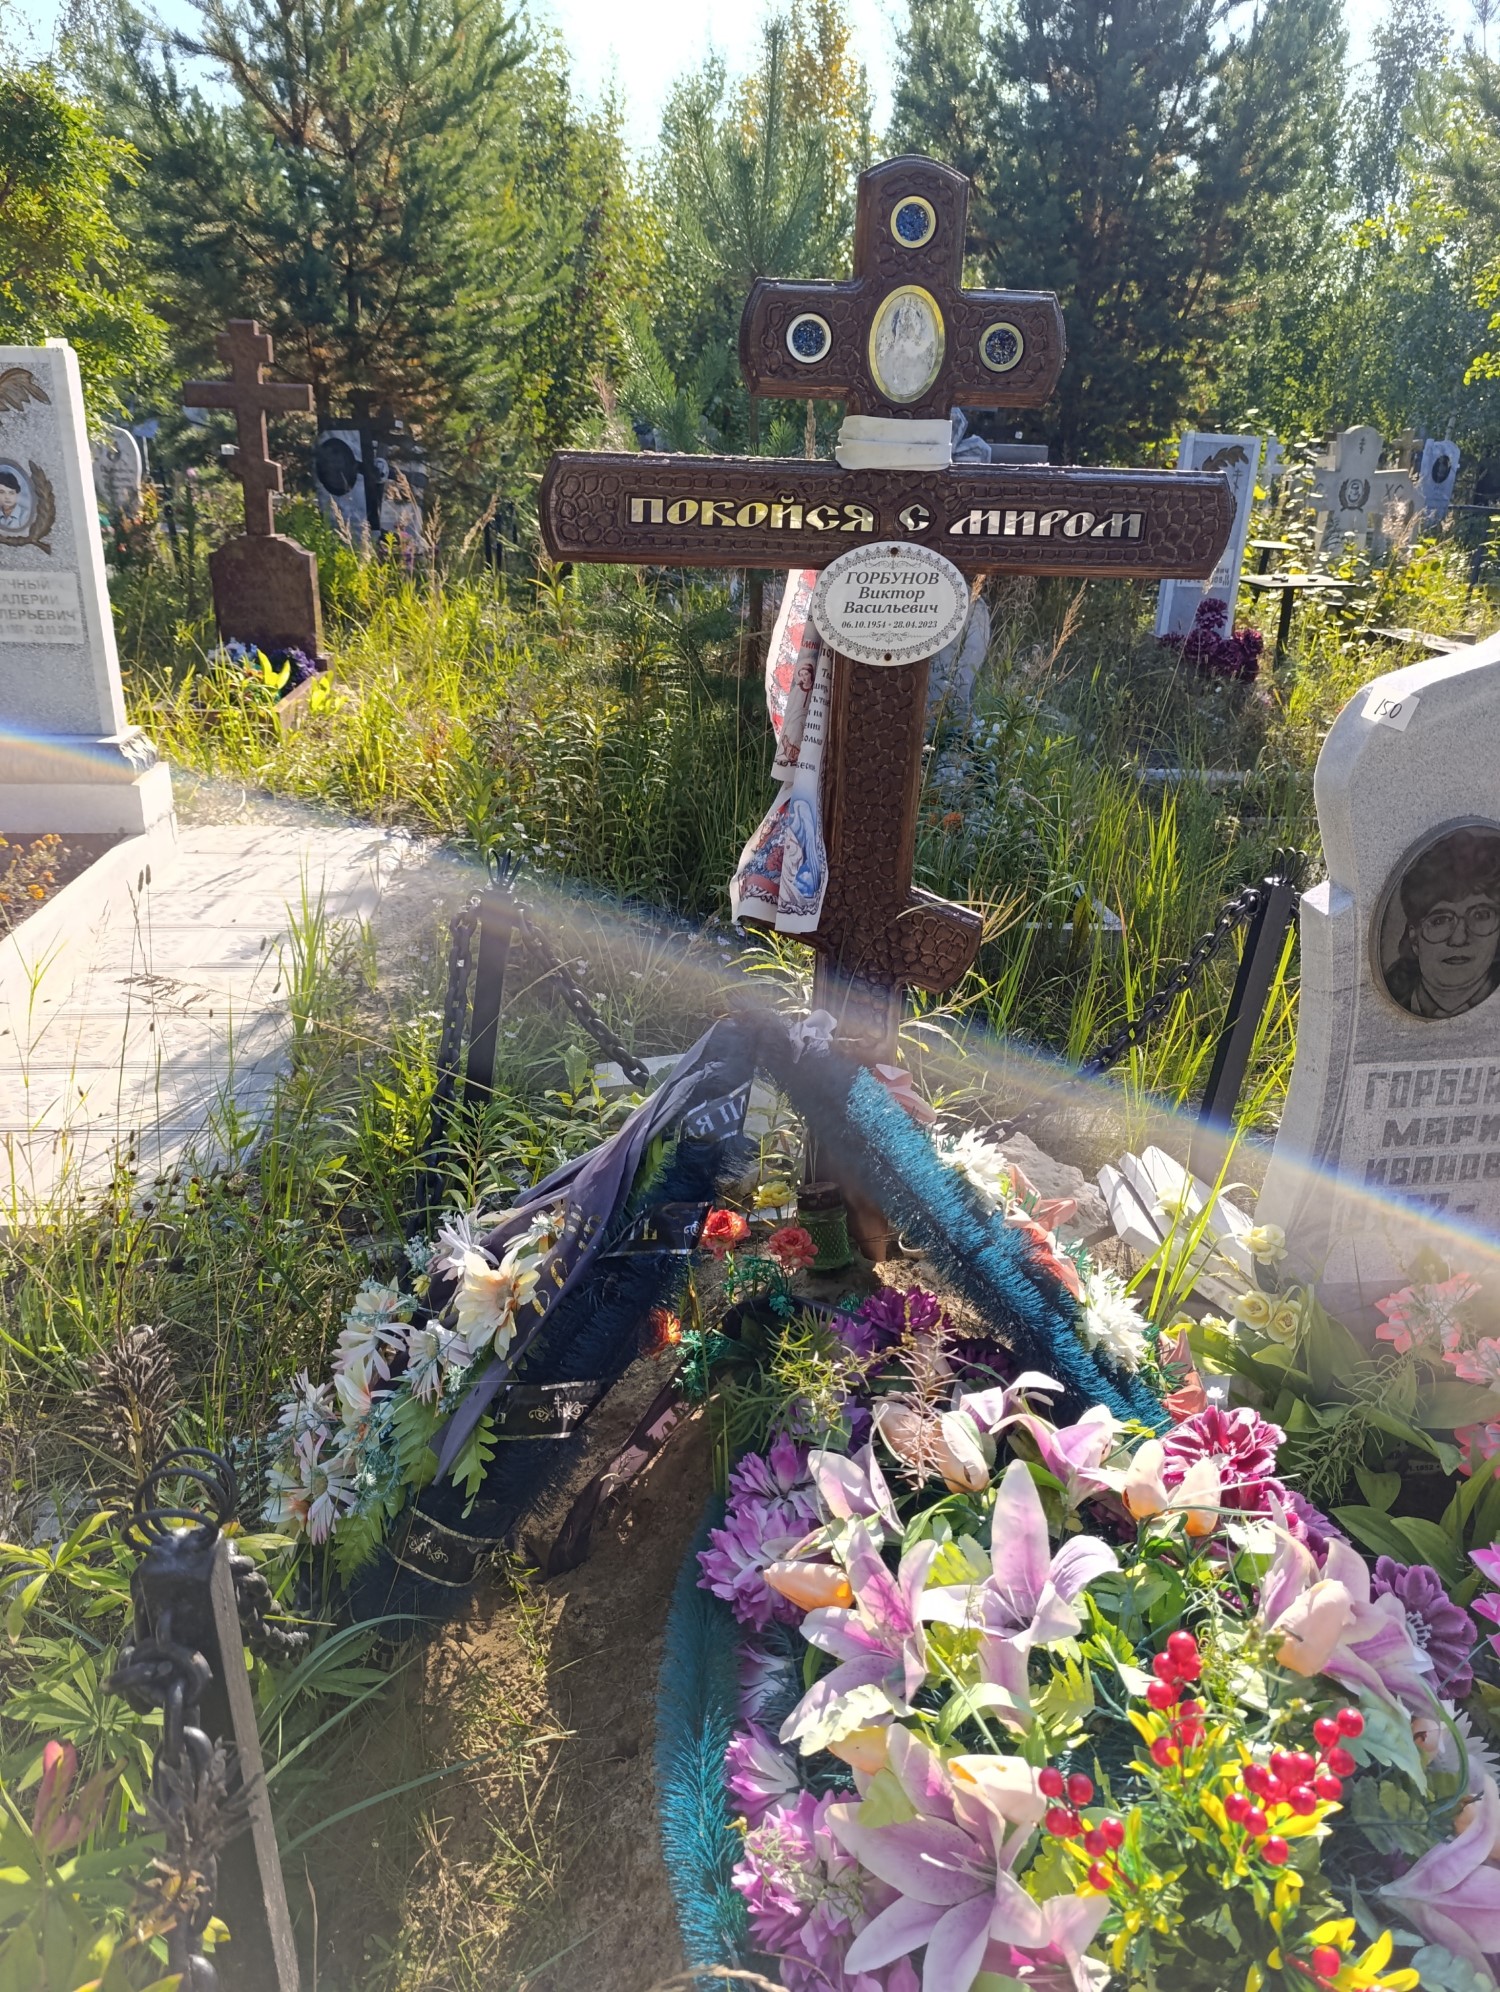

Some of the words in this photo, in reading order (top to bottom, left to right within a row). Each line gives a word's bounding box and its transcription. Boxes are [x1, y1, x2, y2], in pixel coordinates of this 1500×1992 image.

[630, 494, 874, 533] ПОКОЙСЯ
[899, 502, 930, 532] С
[948, 508, 1145, 539] МИРОМ
[845, 571, 940, 585] ГОРБУНОВ
[858, 586, 926, 602] Виктор
[843, 601, 939, 614] Васильевич
[841, 620, 886, 629] 06.10.1954
[892, 620, 938, 629] 28.04.2023
[1373, 697, 1403, 720] 150
